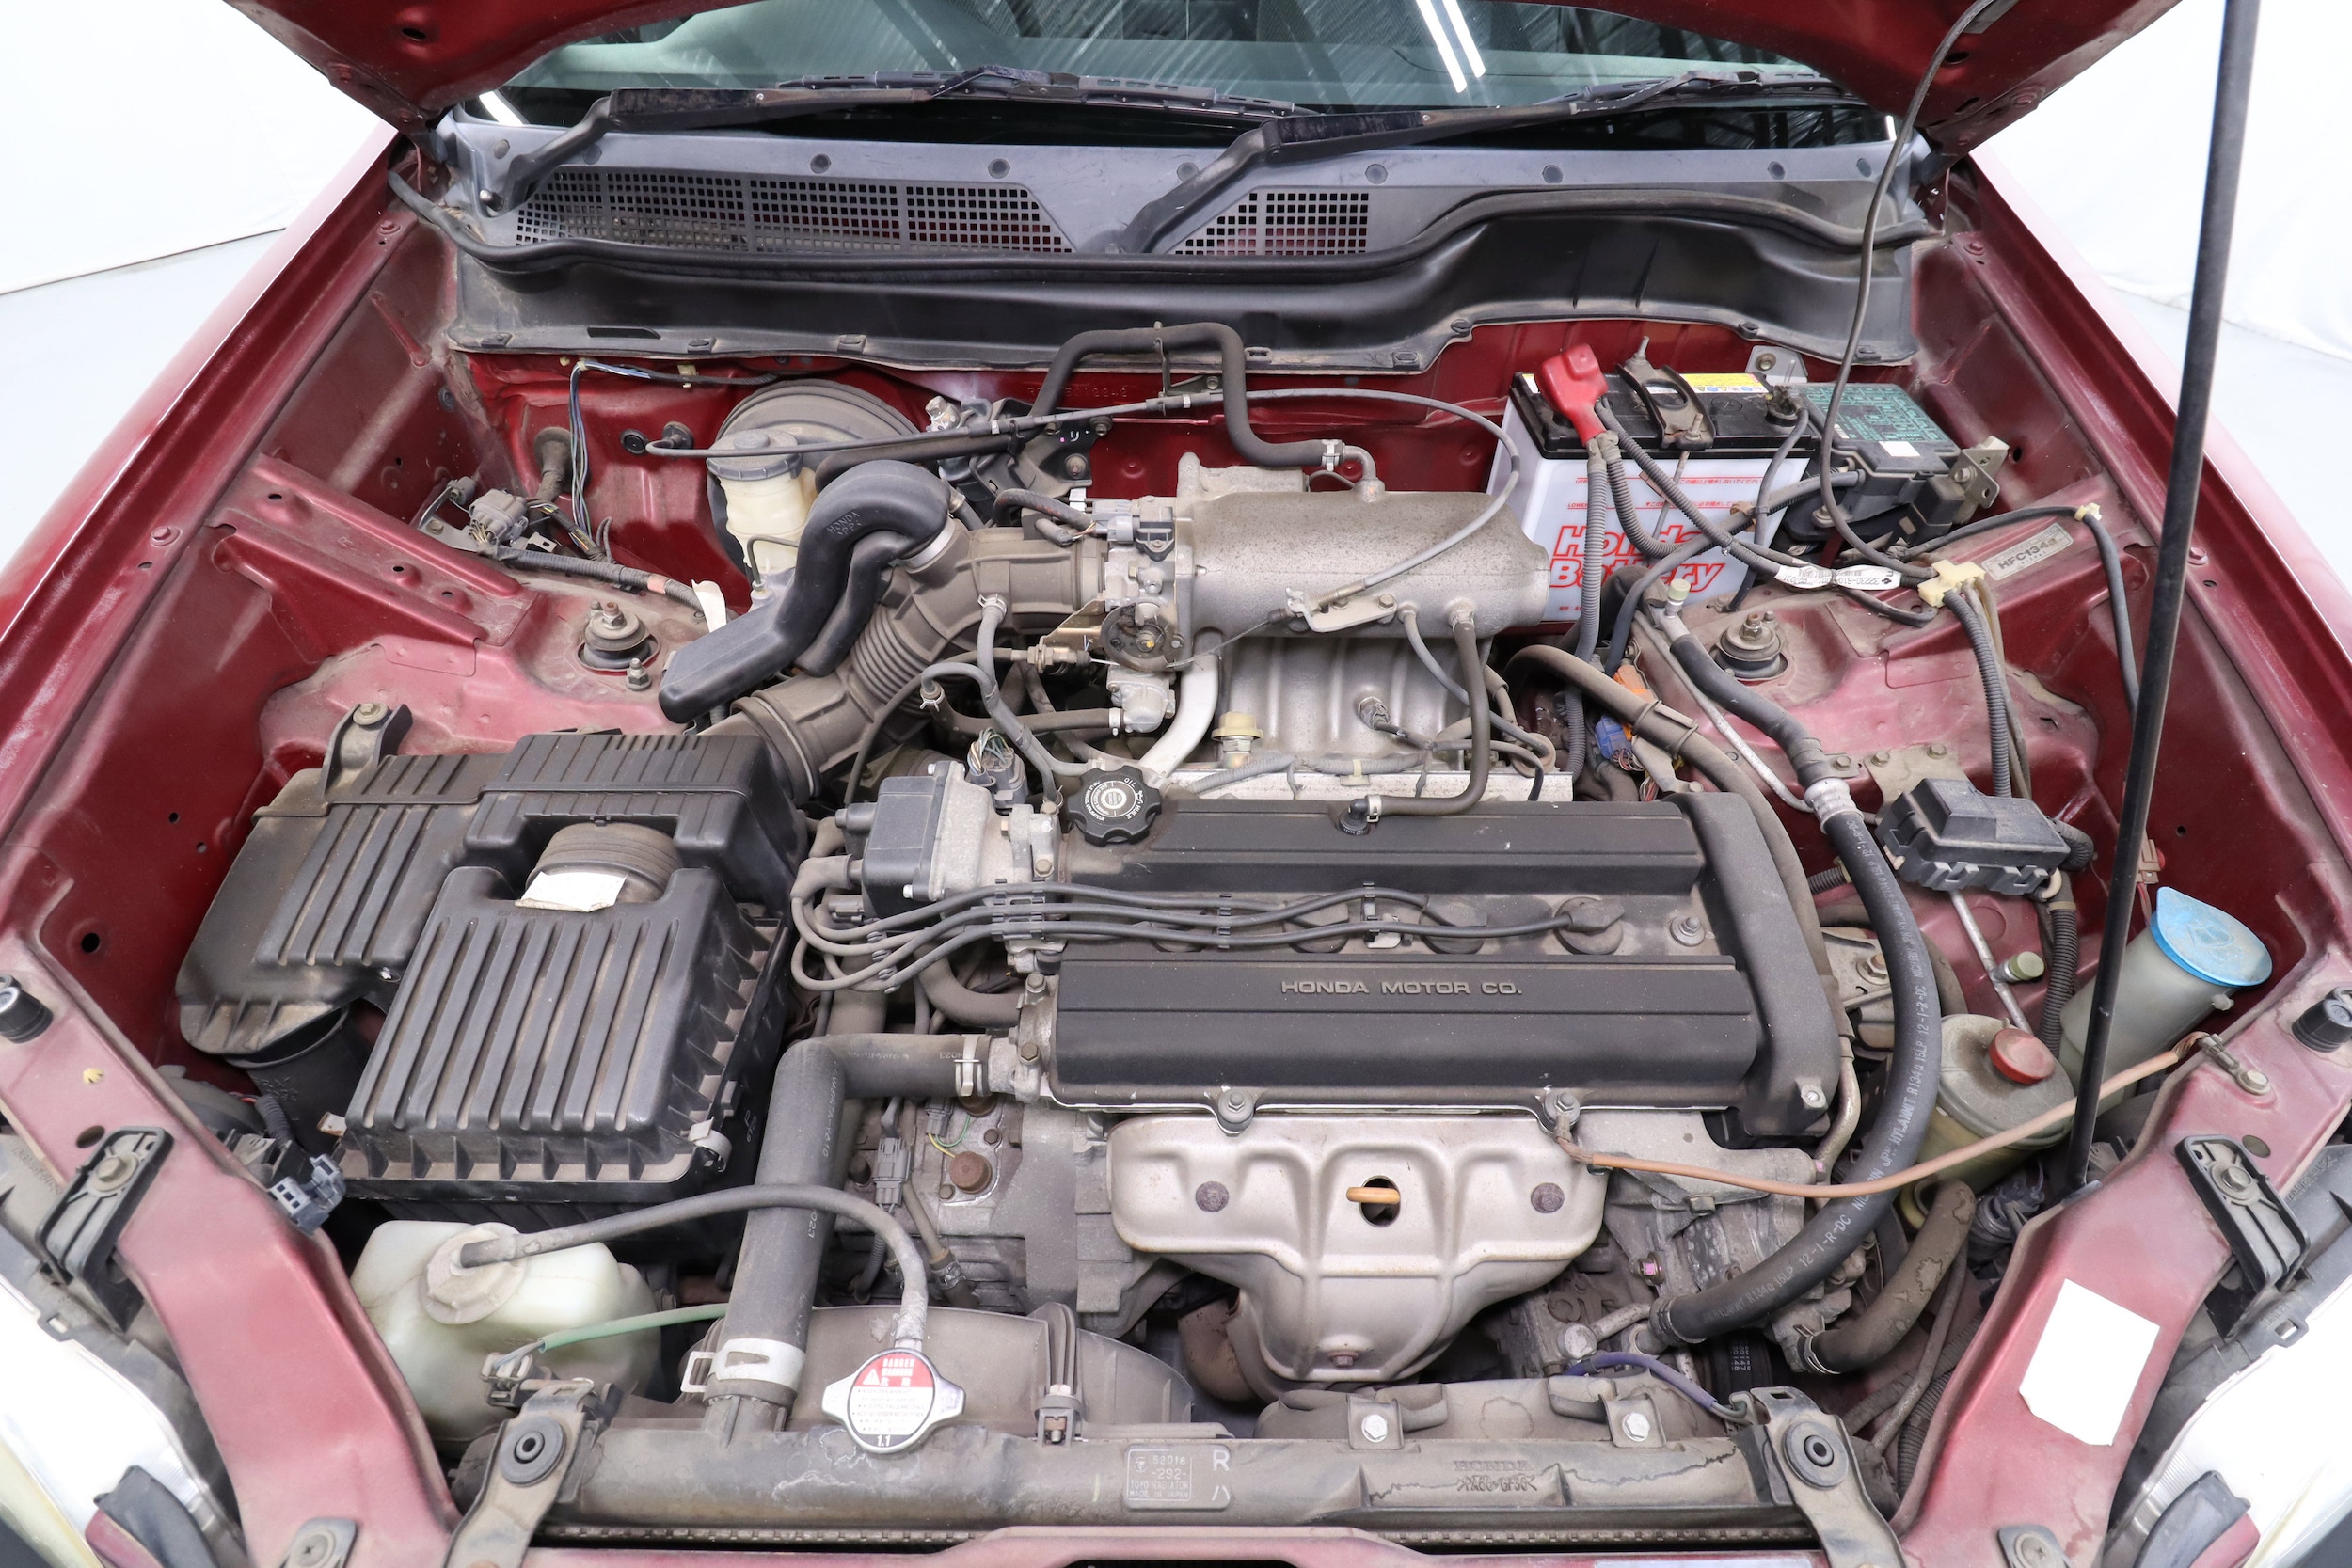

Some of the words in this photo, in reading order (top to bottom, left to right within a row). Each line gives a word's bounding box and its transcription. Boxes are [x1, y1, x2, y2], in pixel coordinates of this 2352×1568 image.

[1997, 538, 2058, 570] HFC134a
[1123, 777, 1136, 788] OIL
[1125, 804, 1142, 820] HUILE
[1281, 981, 1369, 995] HONDA
[1381, 981, 1470, 995] MOTOR
[1482, 981, 1522, 995] CO.
[882, 1358, 915, 1368] DANGER
[876, 1434, 891, 1447] 1.1
[1212, 1449, 1230, 1471] R
[1130, 1481, 1149, 1489] TOYO
